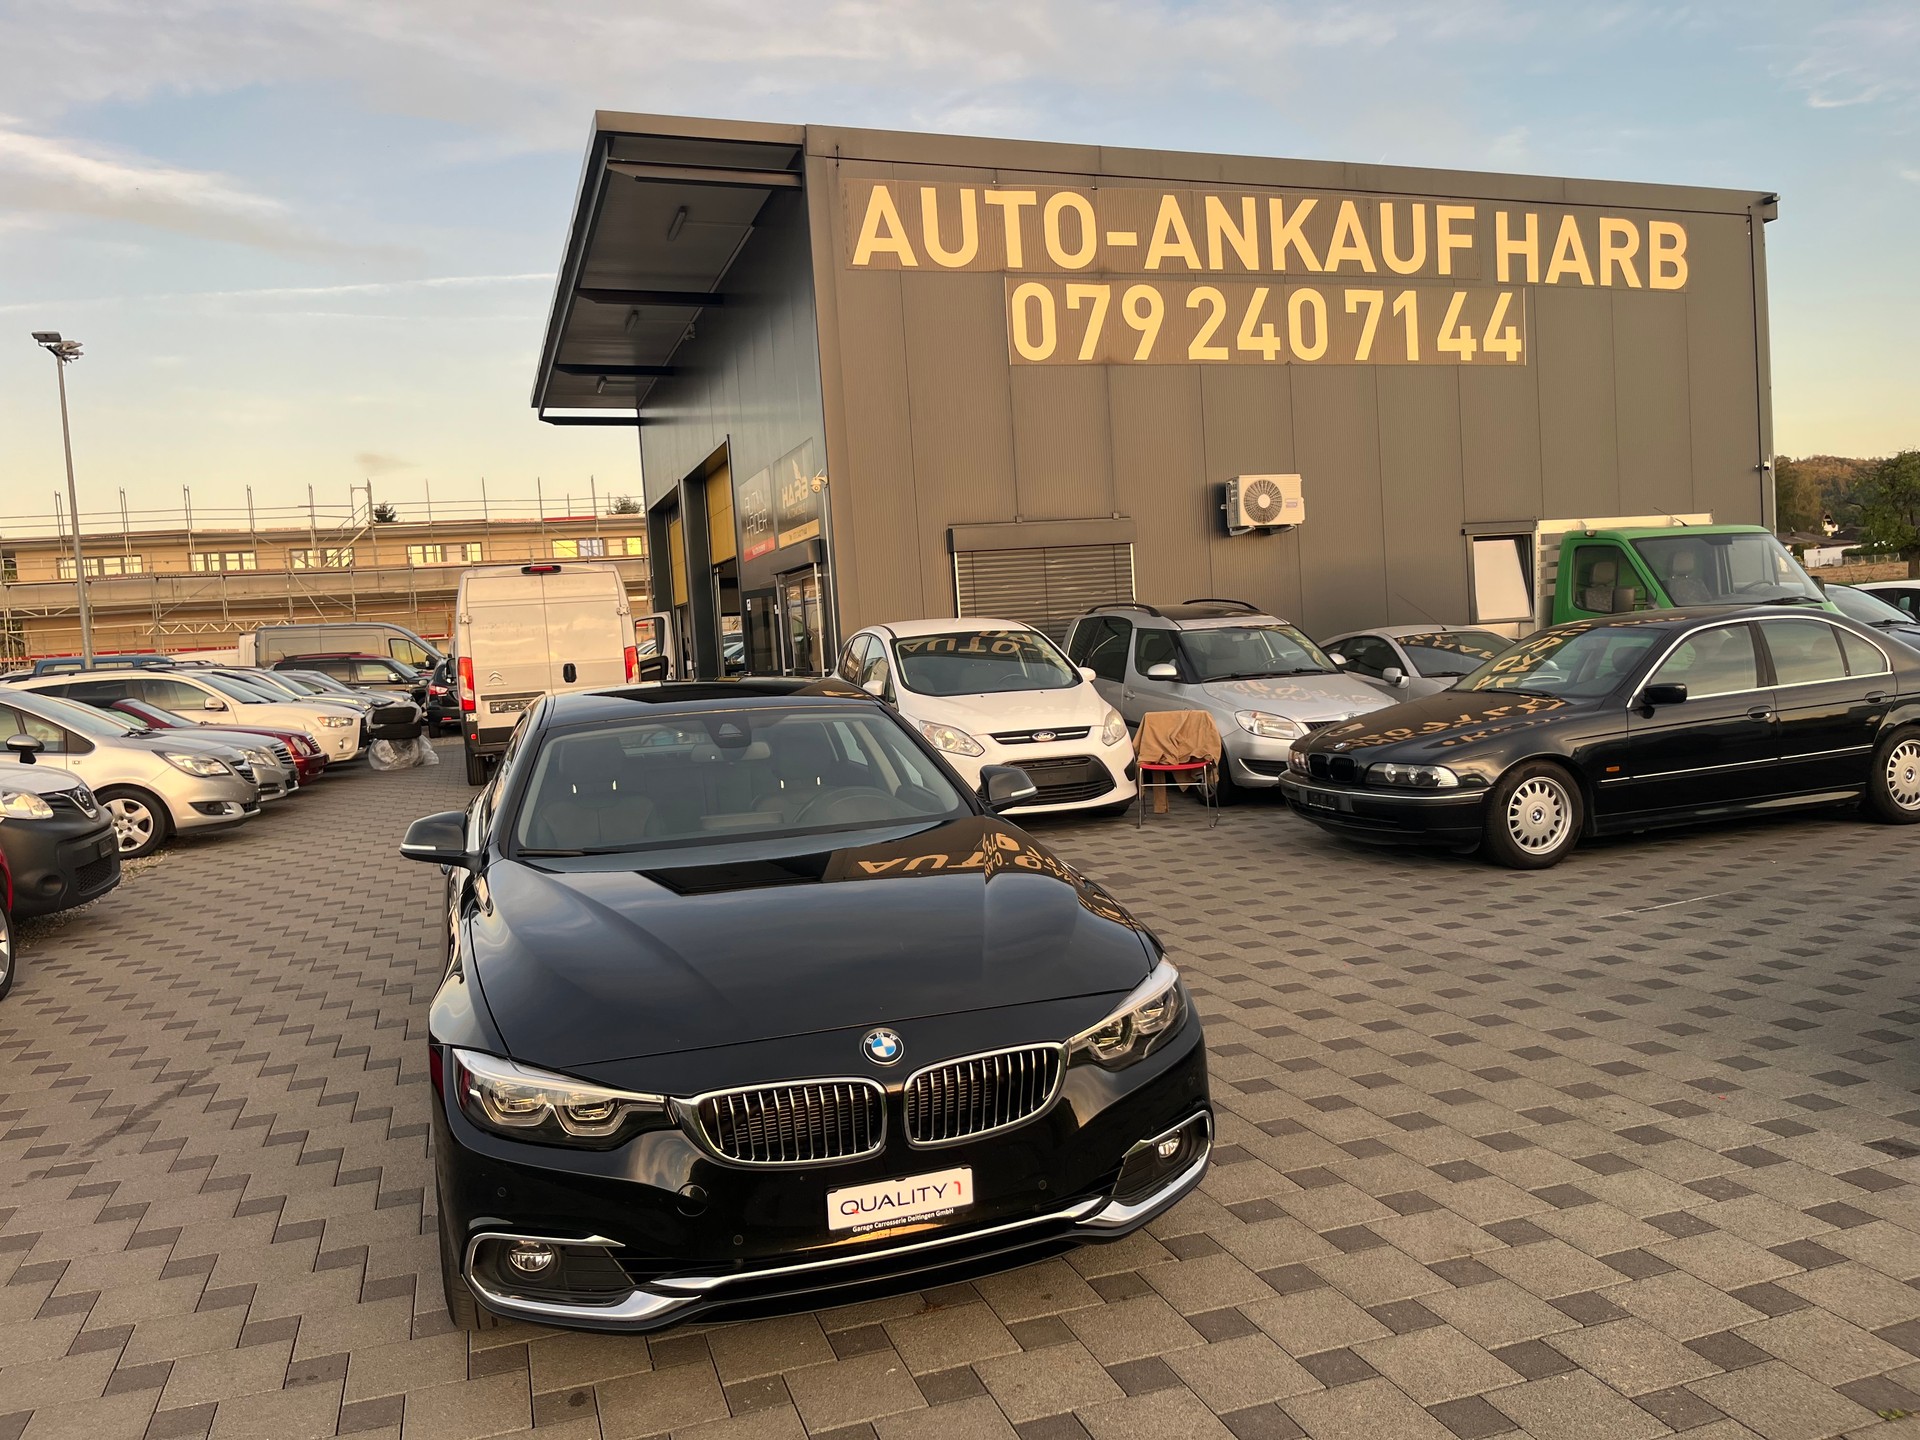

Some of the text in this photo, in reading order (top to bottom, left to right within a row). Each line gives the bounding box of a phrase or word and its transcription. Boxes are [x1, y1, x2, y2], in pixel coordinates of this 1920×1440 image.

[852, 185, 1688, 290] AUTO-ANKAUF HARB
[1011, 281, 1522, 362] 079 240 71 44
[782, 475, 809, 510] HARB
[840, 1181, 962, 1216] QUALITY 1
[852, 1223, 874, 1233] Garage
[874, 1216, 907, 1229] Carrosserie
[936, 1207, 954, 1217] GmbH
